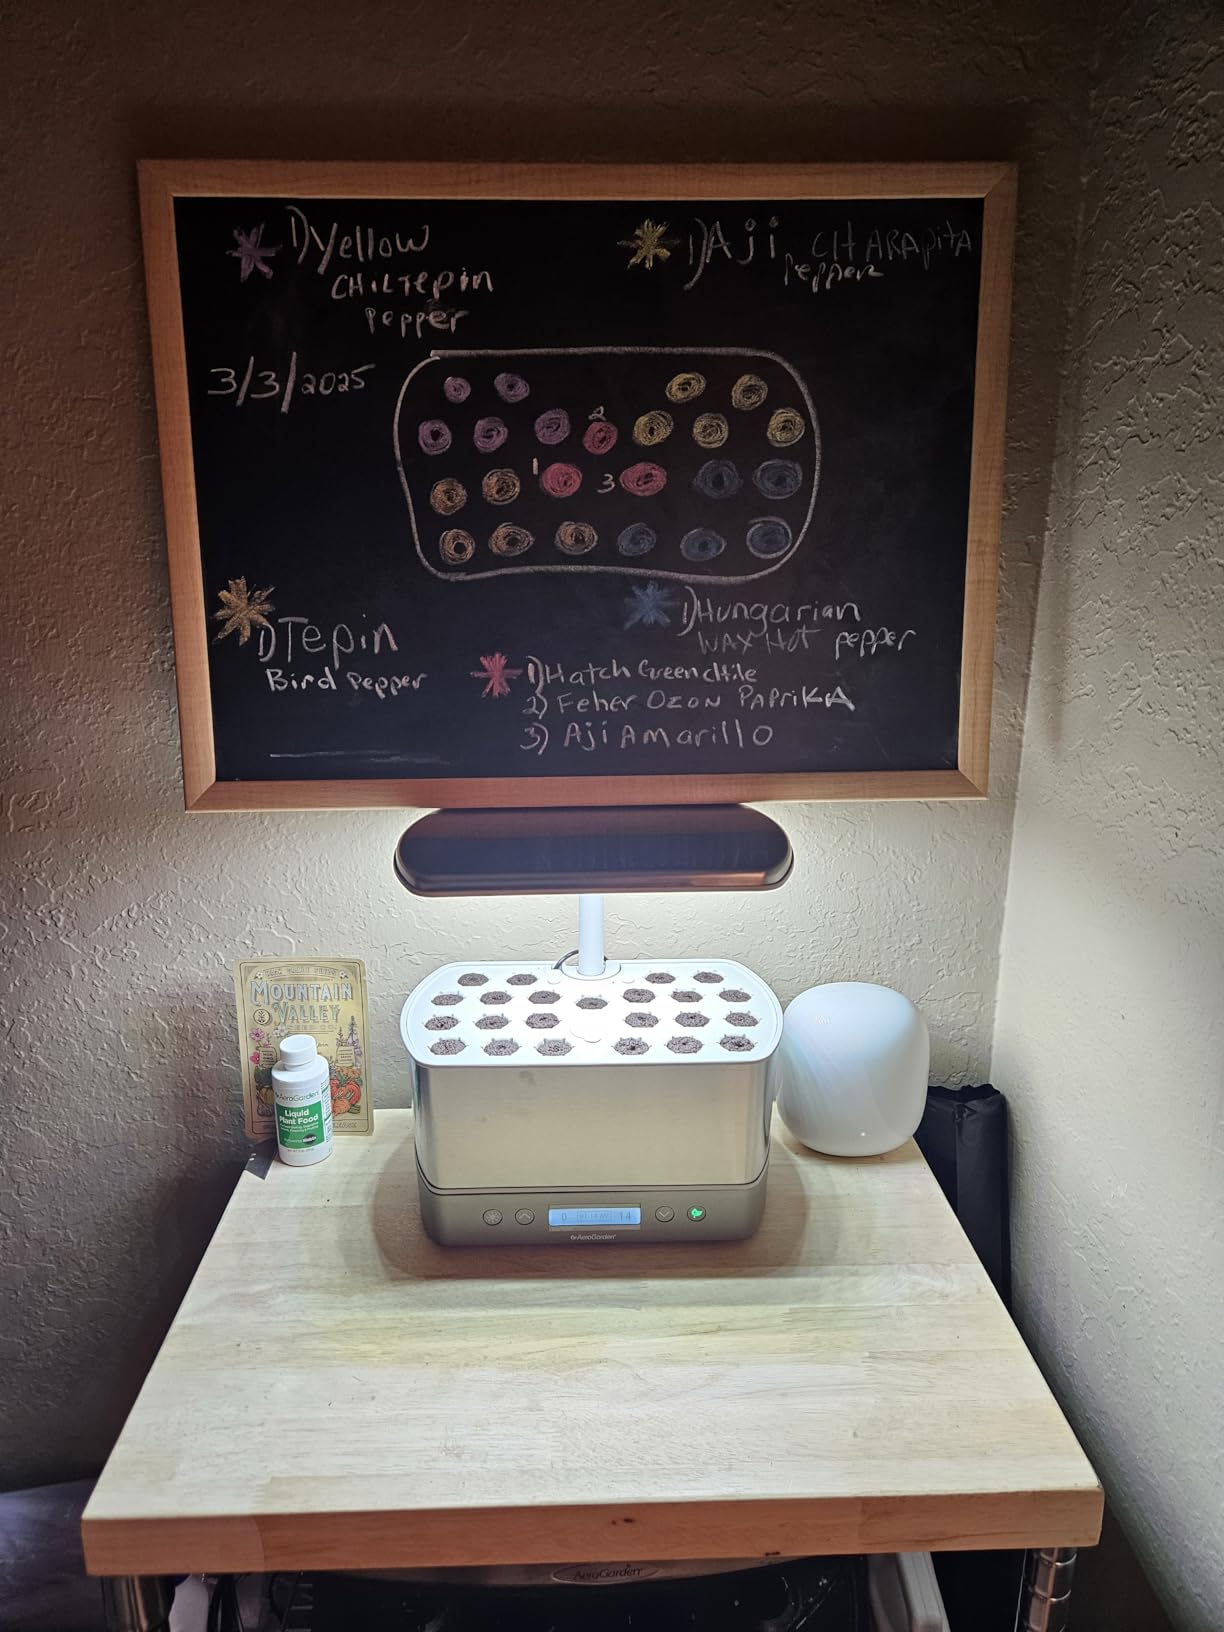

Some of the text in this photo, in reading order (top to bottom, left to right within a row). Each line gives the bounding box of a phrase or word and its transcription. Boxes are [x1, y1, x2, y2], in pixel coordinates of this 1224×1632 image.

[207, 351, 376, 414] 3/3/2025
[588, 405, 606, 421] 2
[597, 473, 616, 493] 3
[266, 666, 337, 692] Bird
[556, 690, 639, 715] Feher
[519, 722, 550, 756] 3)
[563, 720, 608, 752] Aji
[251, 980, 353, 1006] MOUNTAIN
[272, 1001, 341, 1024] VALLEY
[279, 1115, 296, 1125] Plant
[297, 1113, 319, 1125] Food
[284, 1109, 310, 1118] Liquid
